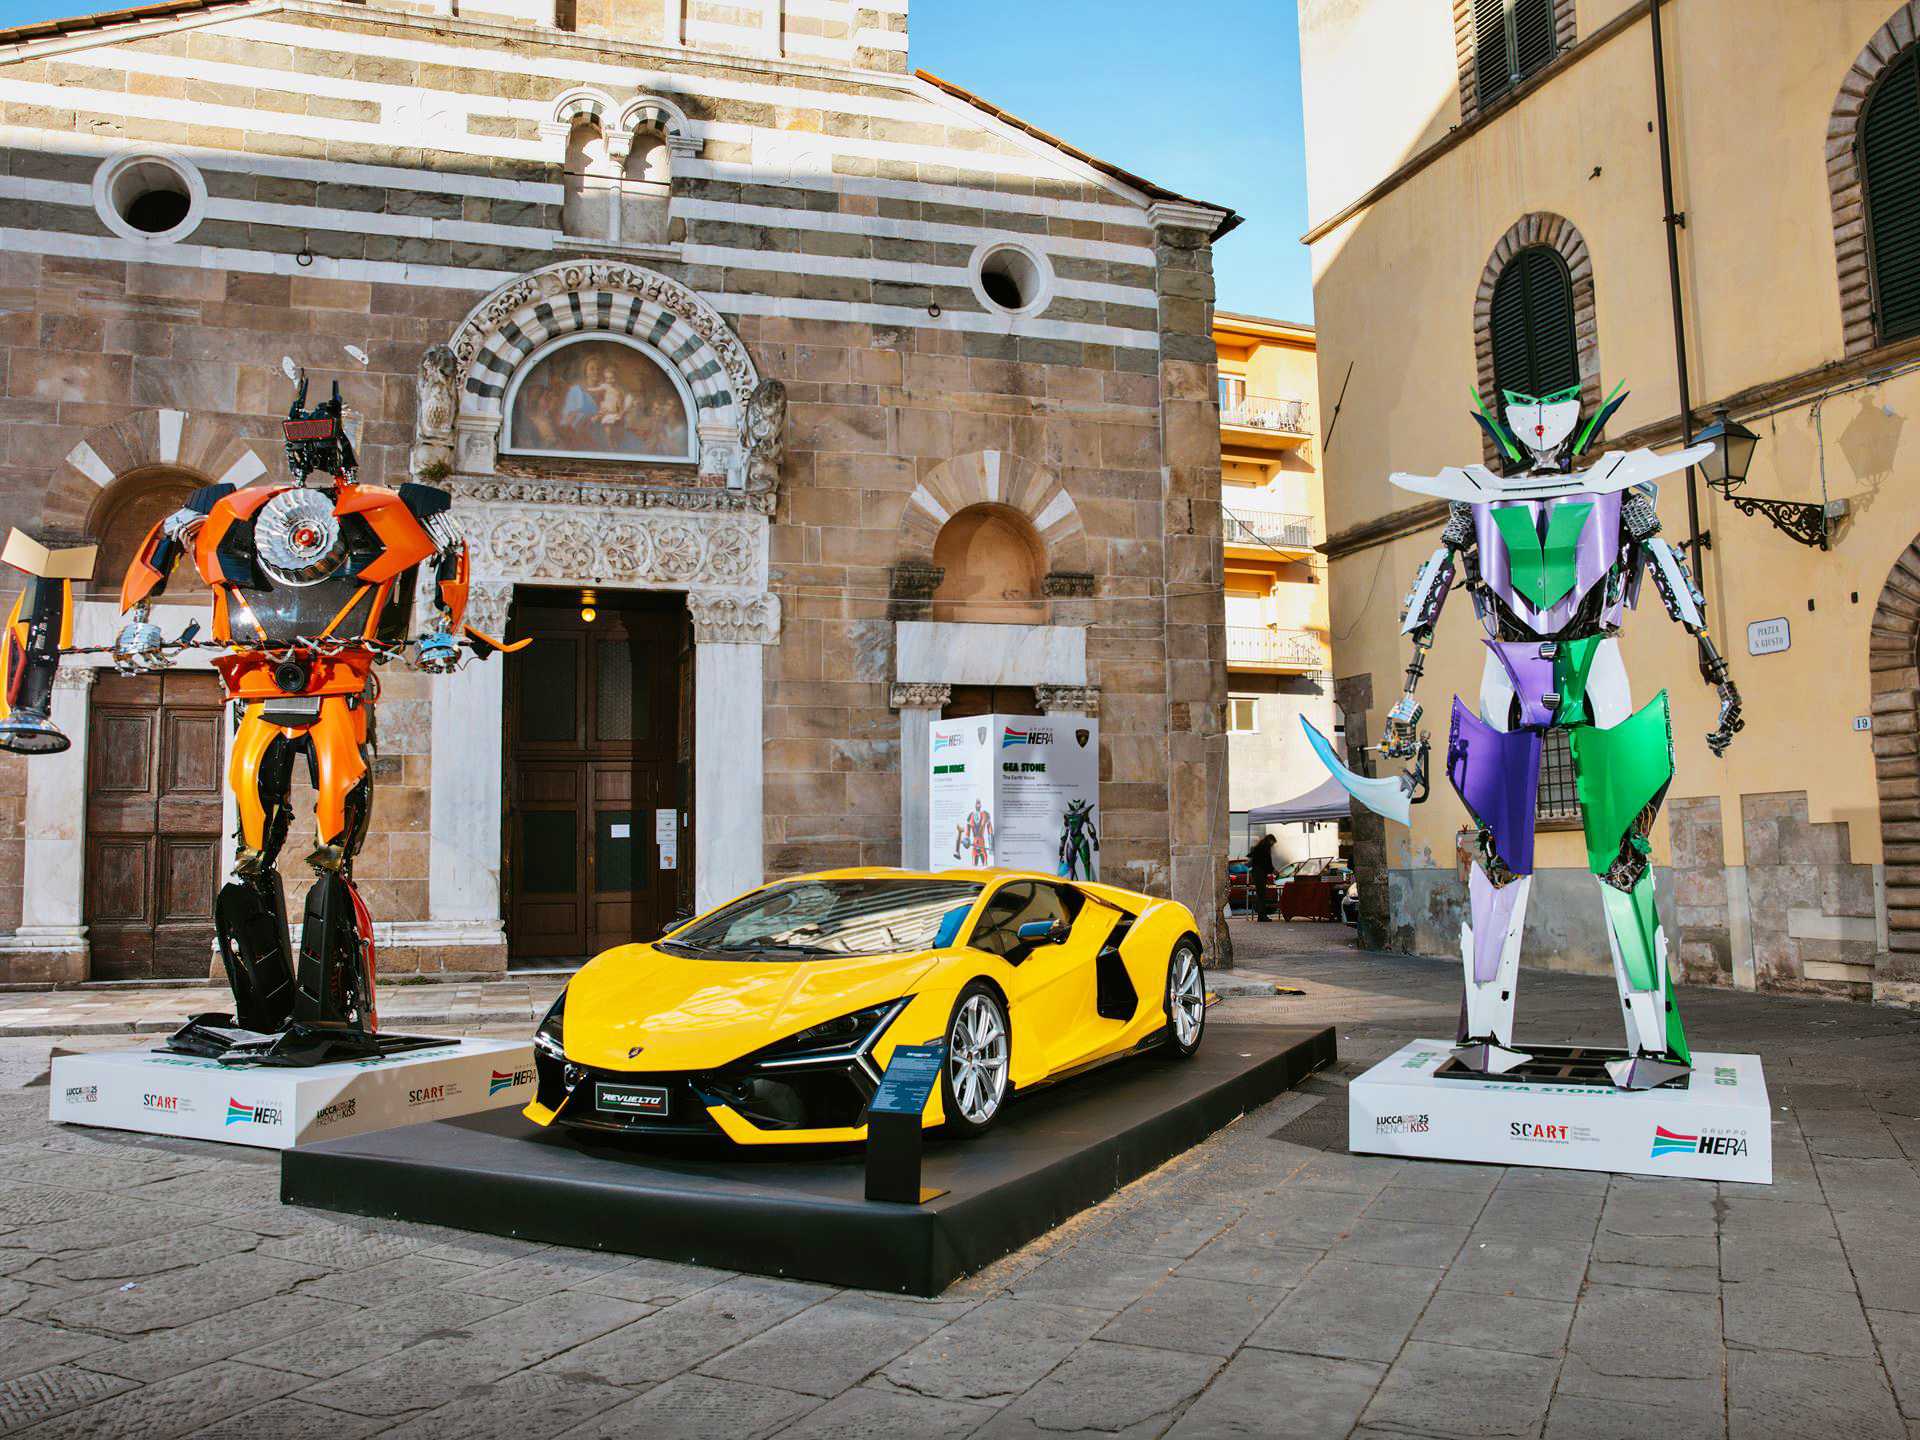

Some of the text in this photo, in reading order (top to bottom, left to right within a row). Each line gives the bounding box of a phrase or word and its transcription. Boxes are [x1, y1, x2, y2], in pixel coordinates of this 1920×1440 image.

[1757, 625, 1780, 637] PIAZZA
[1761, 637, 1785, 649] GIUSTO
[1857, 718, 1868, 729] 19
[1027, 732, 1054, 745] HERA
[1002, 762, 1047, 773] GEA STONE
[512, 1069, 537, 1087] HERA
[67, 1087, 82, 1097] LUCCA
[409, 1085, 445, 1103] SCART
[1483, 1084, 1531, 1092] GEA
[143, 1093, 178, 1110] SCART
[602, 1092, 662, 1105] REVUELTO
[253, 1107, 282, 1126] HERA
[316, 1104, 337, 1119] LUCCA
[1376, 1115, 1403, 1125] LUCCA
[1418, 1114, 1429, 1123] 25
[1410, 1122, 1429, 1133] KISS
[1510, 1122, 1569, 1141] SCART
[1701, 1127, 1747, 1136] GRUPPO
[1698, 1136, 1748, 1157] HERA
